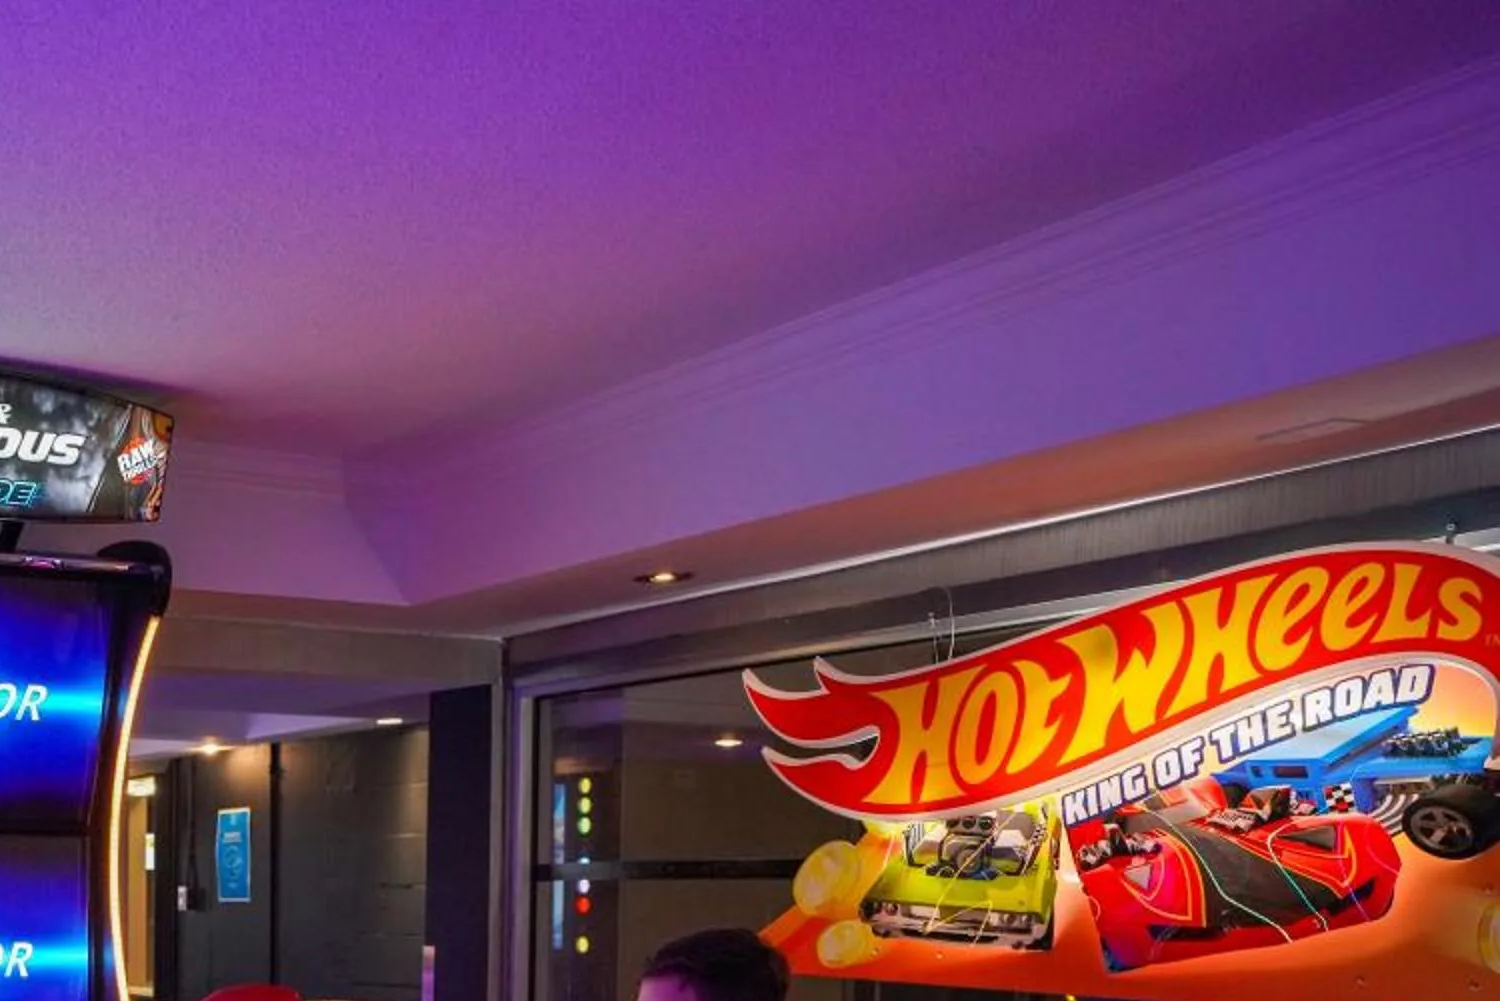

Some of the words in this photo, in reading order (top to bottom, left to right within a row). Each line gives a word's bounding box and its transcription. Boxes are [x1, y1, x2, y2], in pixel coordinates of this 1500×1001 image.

[1063, 765, 1148, 829] KING
[1153, 736, 1205, 790] OF
[1209, 701, 1294, 763] THE
[1301, 664, 1434, 733] ROAD
